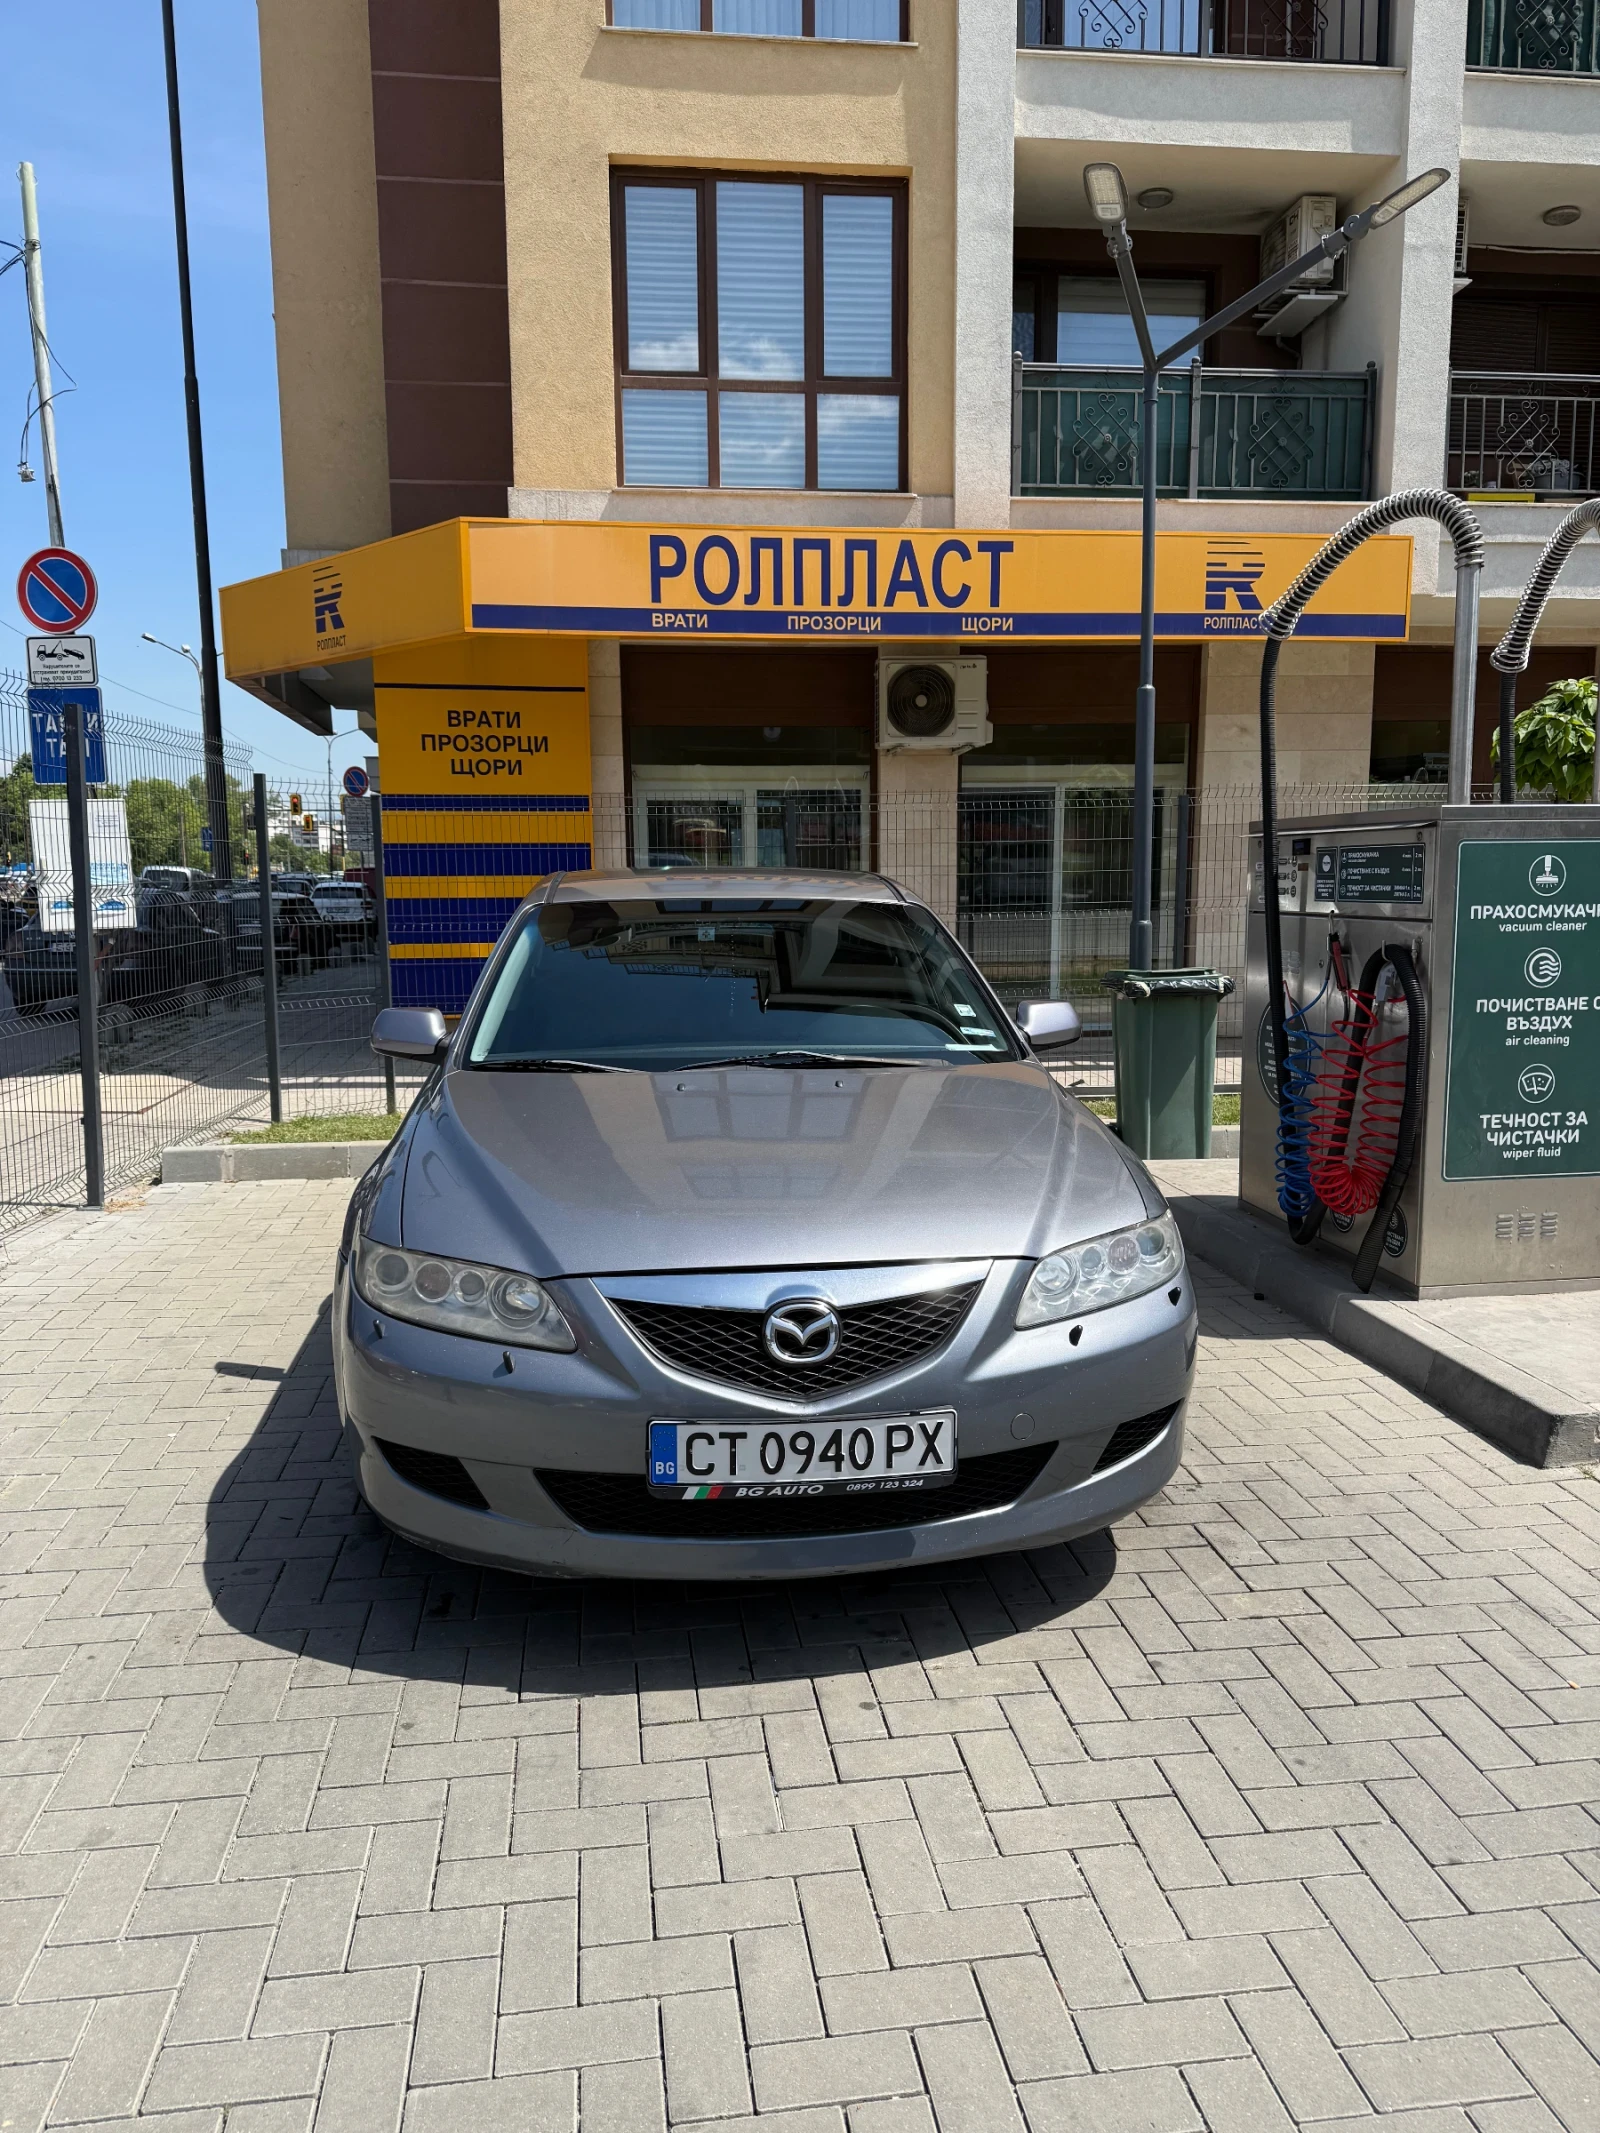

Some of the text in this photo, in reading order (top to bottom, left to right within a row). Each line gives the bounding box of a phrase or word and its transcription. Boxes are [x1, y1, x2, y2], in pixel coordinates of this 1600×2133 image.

[649, 534, 1015, 609] РОЛПЛАСТ
[651, 612, 1014, 634] ВРАТИ ПРОЗОРЦИ ЩОРИ
[1203, 617, 1261, 629] РОЛПЛАС
[447, 709, 521, 728] ВРАТИ
[420, 733, 549, 756] ПРОЗОРЦИ
[450, 758, 523, 778] ЩОРИ
[1499, 921, 1588, 932] vacuum cleaner
[1476, 996, 1589, 1013] ПОЧИСТВАНЕ
[1506, 1015, 1573, 1032] ВЪЗДУХ
[1505, 1034, 1570, 1047] air cleaning
[1479, 1111, 1588, 1129] ТЕЧНОСТ ЗА
[1486, 1129, 1580, 1146] ЧИСТАЧКИ
[1502, 1147, 1562, 1161] wiper fluid
[655, 1462, 675, 1475] BG
[735, 1479, 924, 1497] BG AUTO 0899 123 324
